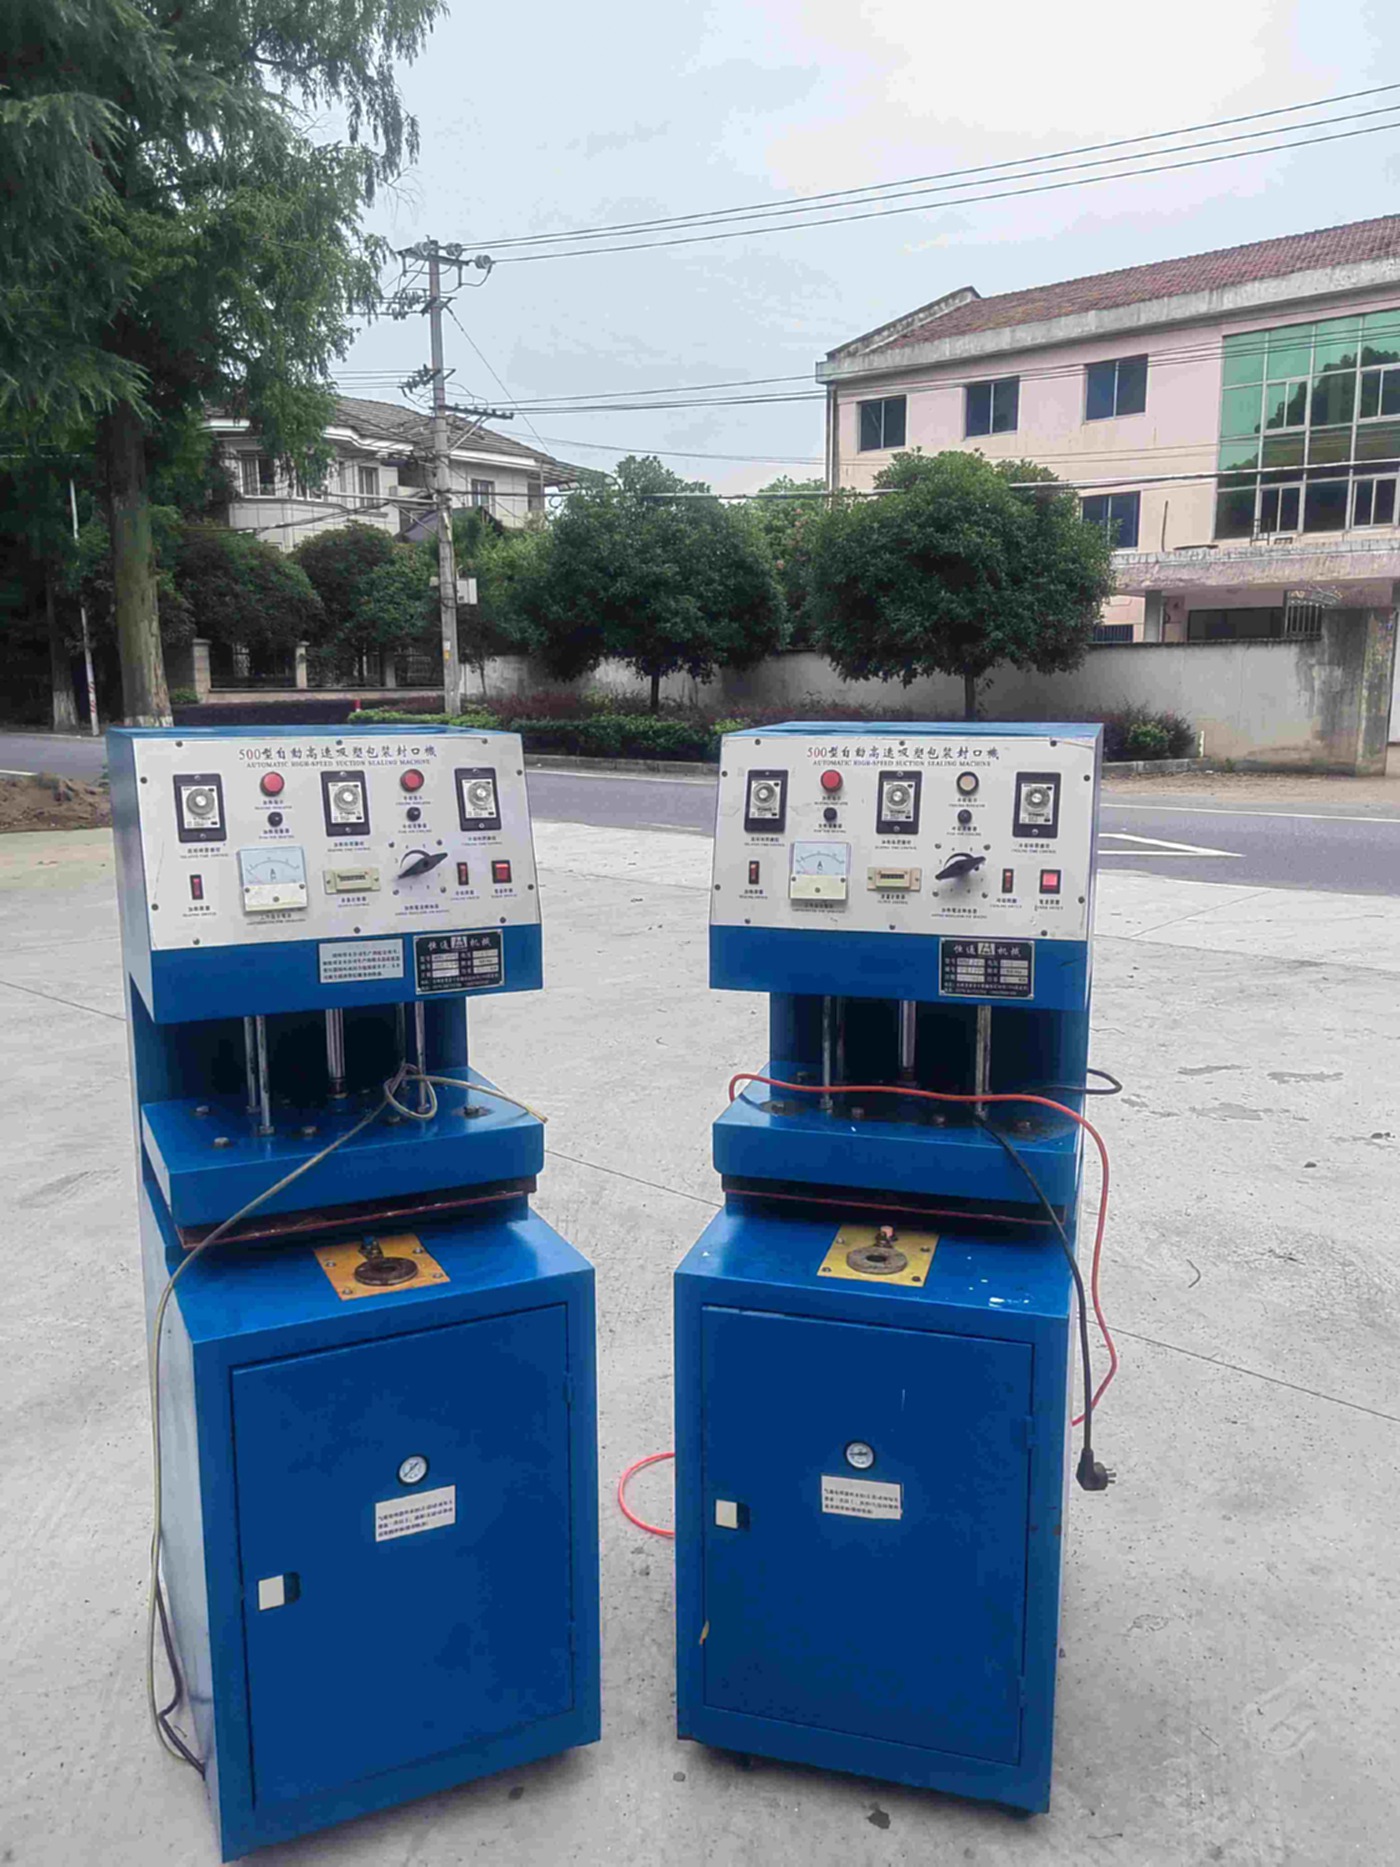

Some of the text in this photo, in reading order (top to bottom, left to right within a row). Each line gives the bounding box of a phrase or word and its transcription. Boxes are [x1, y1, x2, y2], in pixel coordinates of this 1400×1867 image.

[246, 758, 430, 768] AUTOMATIC HIGH-SPEED SUCTION SEALING MACHINE
[896, 760, 925, 768] SUCTION
[927, 760, 957, 768] SEALING
[959, 760, 991, 768] MACHINE
